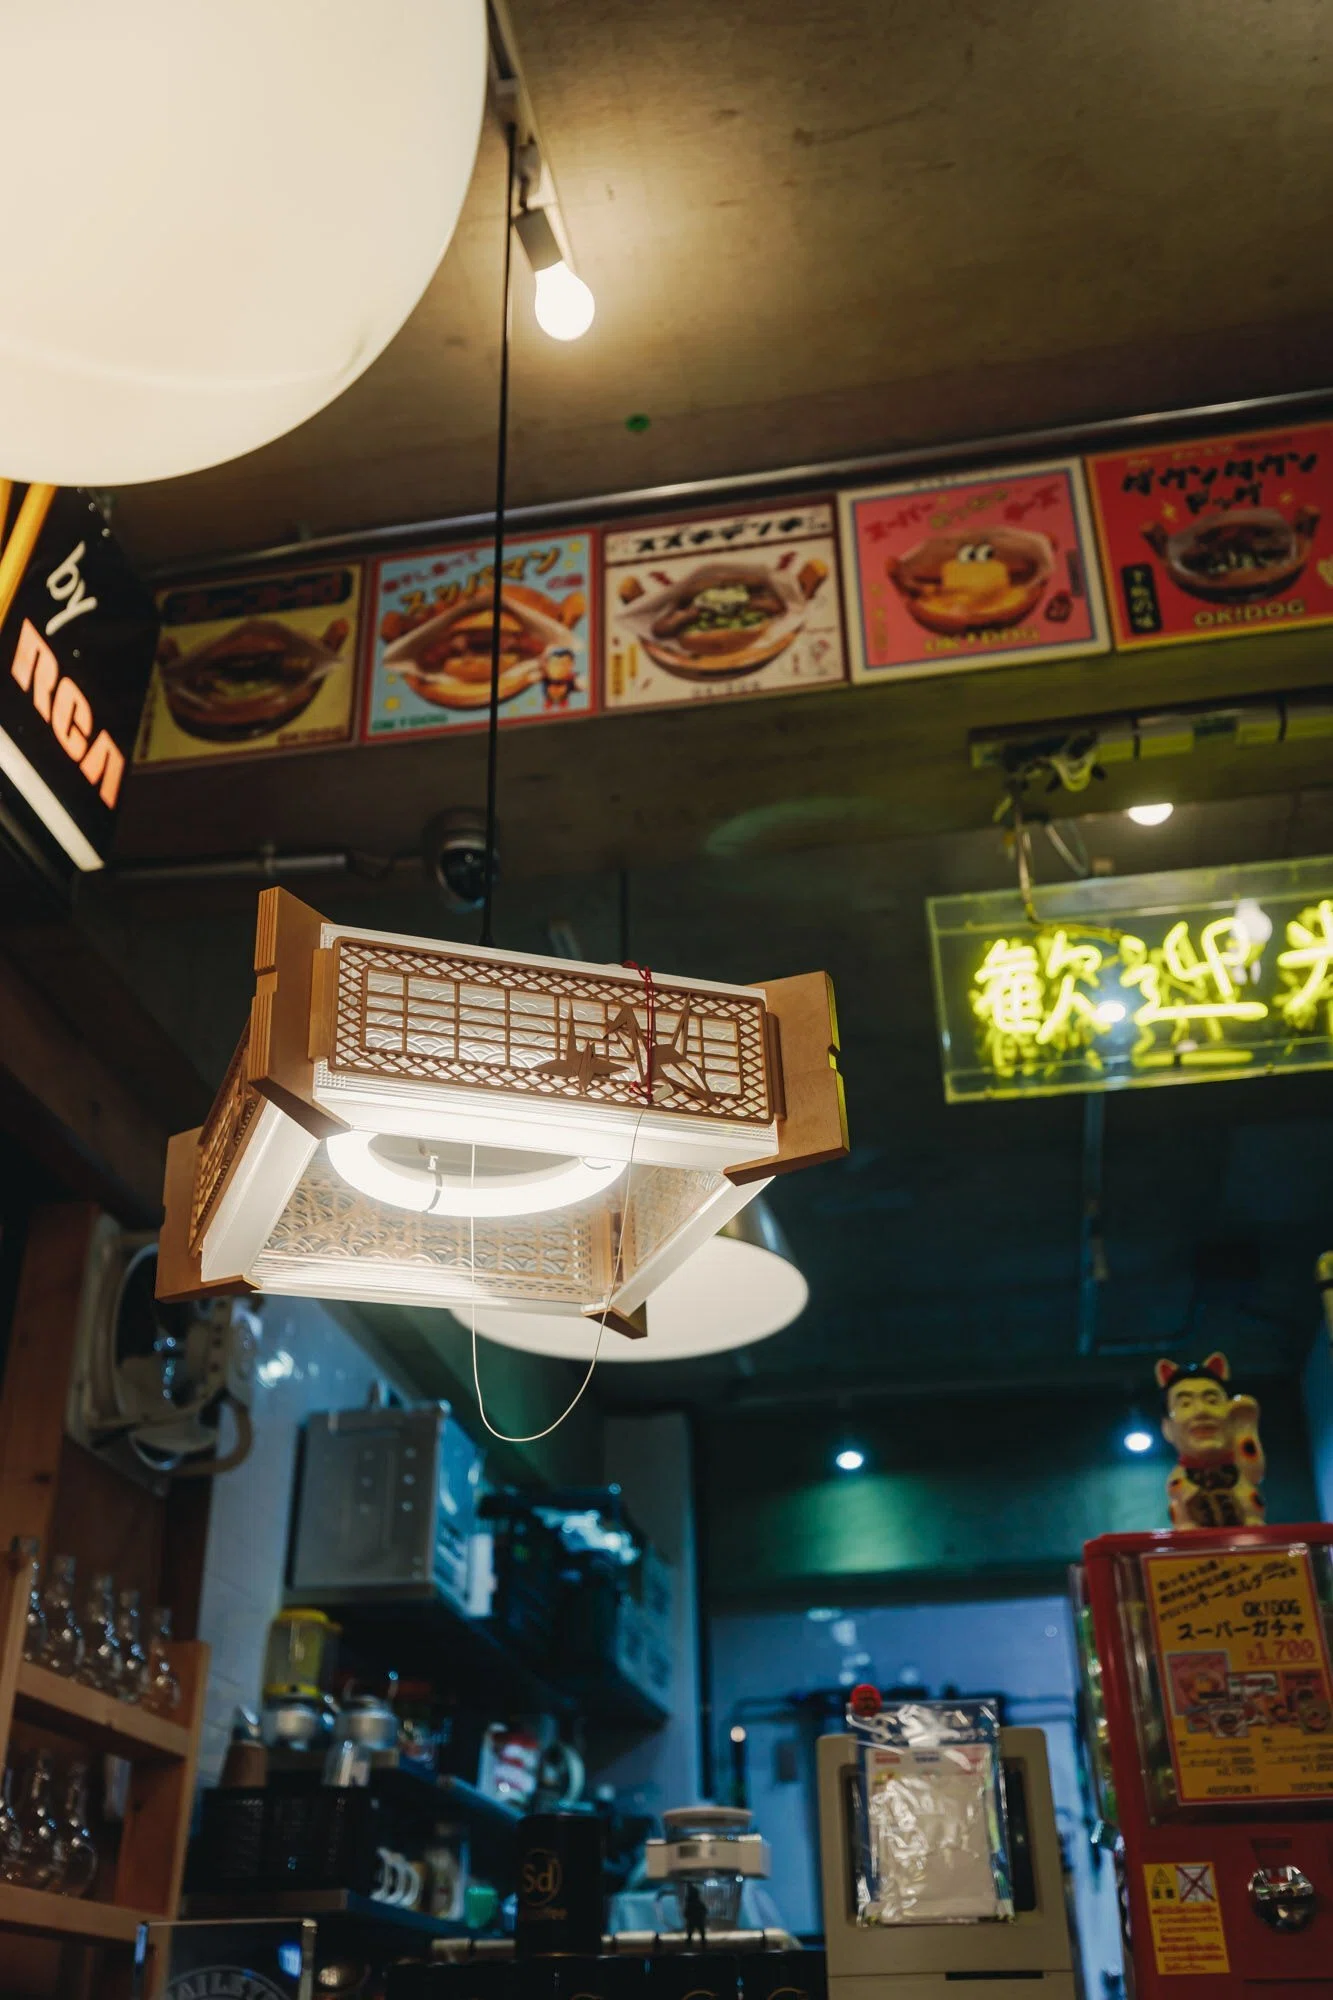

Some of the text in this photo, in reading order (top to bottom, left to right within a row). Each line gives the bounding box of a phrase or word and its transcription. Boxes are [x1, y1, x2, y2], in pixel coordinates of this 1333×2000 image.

[45, 539, 98, 637] by
[11, 616, 126, 810] RCA
[1176, 1619, 1306, 1642] スーパーガチャ
